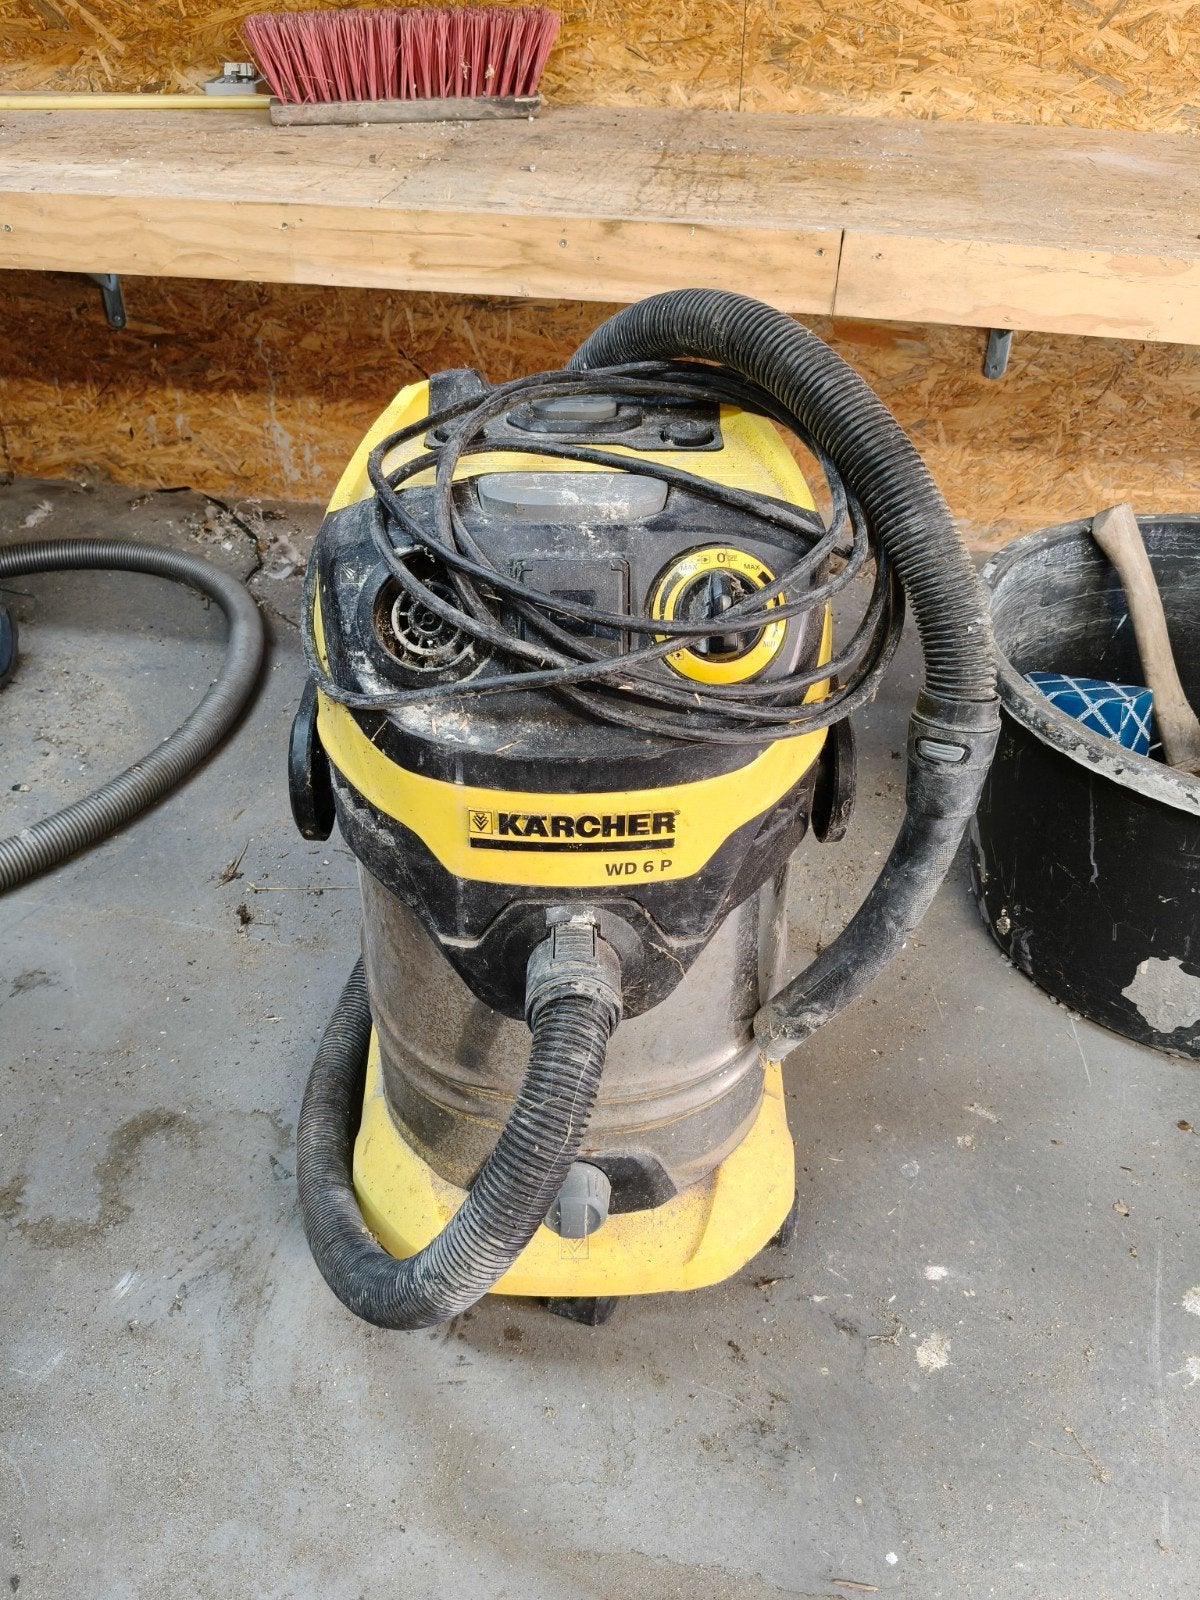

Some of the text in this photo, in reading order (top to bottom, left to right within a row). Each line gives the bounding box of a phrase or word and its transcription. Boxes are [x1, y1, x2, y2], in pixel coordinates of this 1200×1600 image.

[680, 564, 698, 572] MAX
[743, 563, 760, 571] MAX
[498, 811, 676, 838] KÄRCHER
[605, 859, 673, 876] WD 6 P
